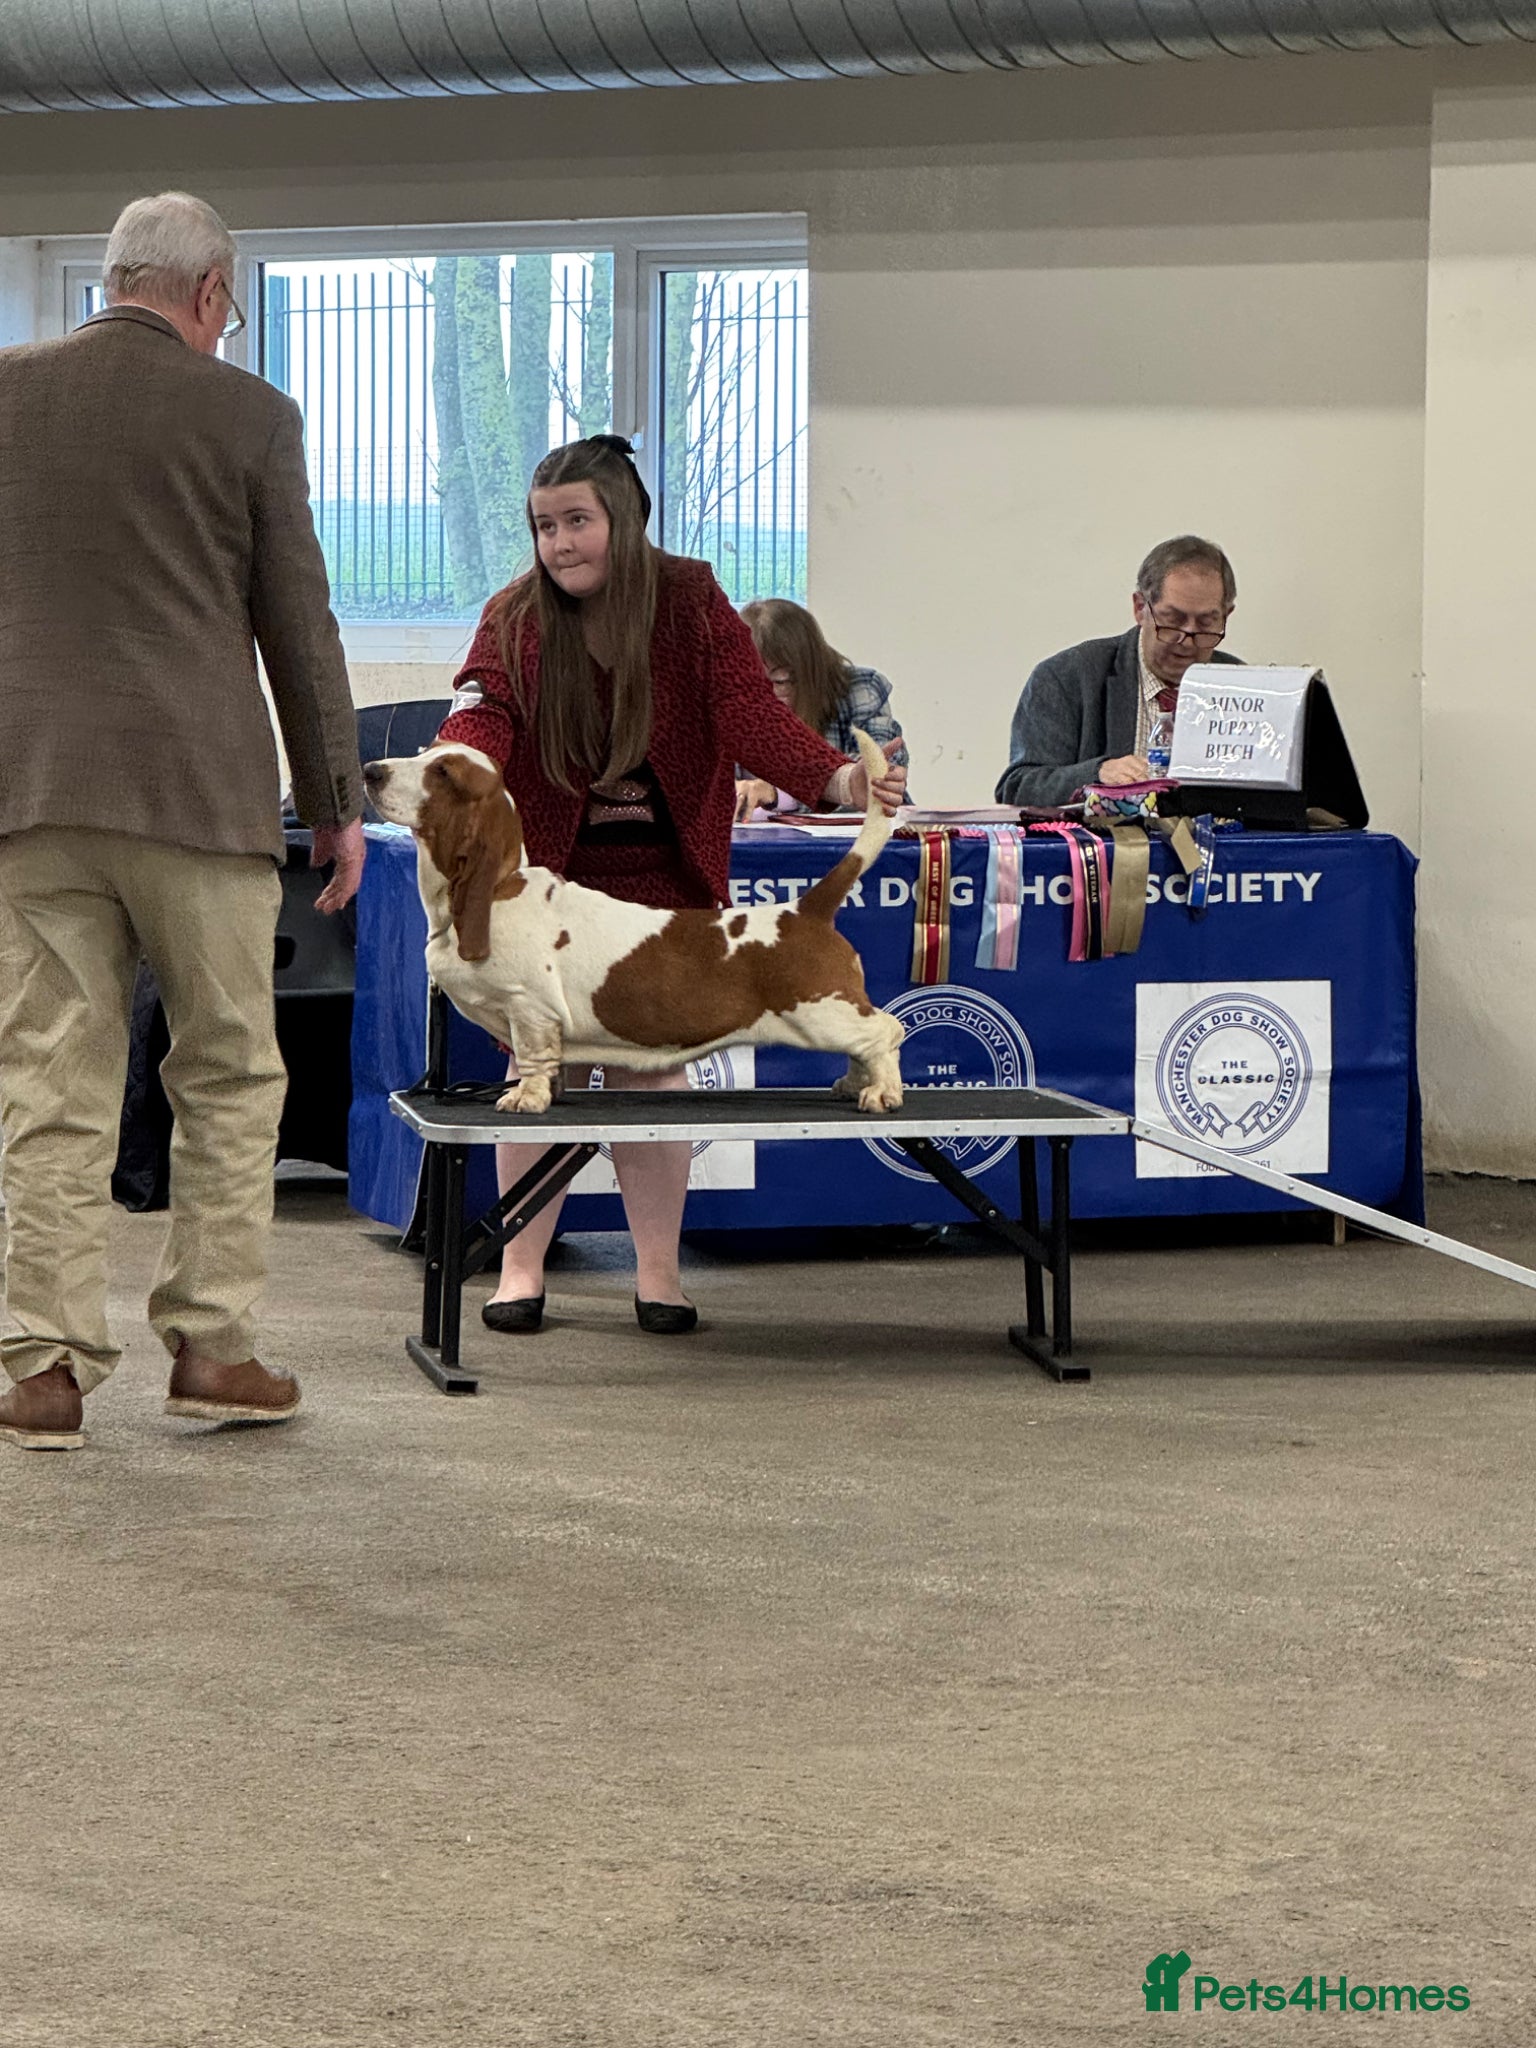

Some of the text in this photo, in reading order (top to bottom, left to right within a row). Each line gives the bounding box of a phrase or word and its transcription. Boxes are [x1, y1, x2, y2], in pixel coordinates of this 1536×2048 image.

[1208, 697, 1264, 712] MINOR
[1208, 720, 1259, 736] PUPPY
[1205, 744, 1254, 760] BITCH
[728, 872, 1322, 908] ESTR DG HO SOCIETY
[1089, 864, 1098, 903] VETERAN
[914, 1006, 953, 1025] DOG
[958, 1009, 1005, 1047] SHOW
[927, 1064, 957, 1075] THE
[1174, 1012, 1295, 1125] MANCHESTER DOG SHOW SOCIETY
[1221, 1060, 1248, 1069] THE
[1198, 1074, 1275, 1084] CLASSIC
